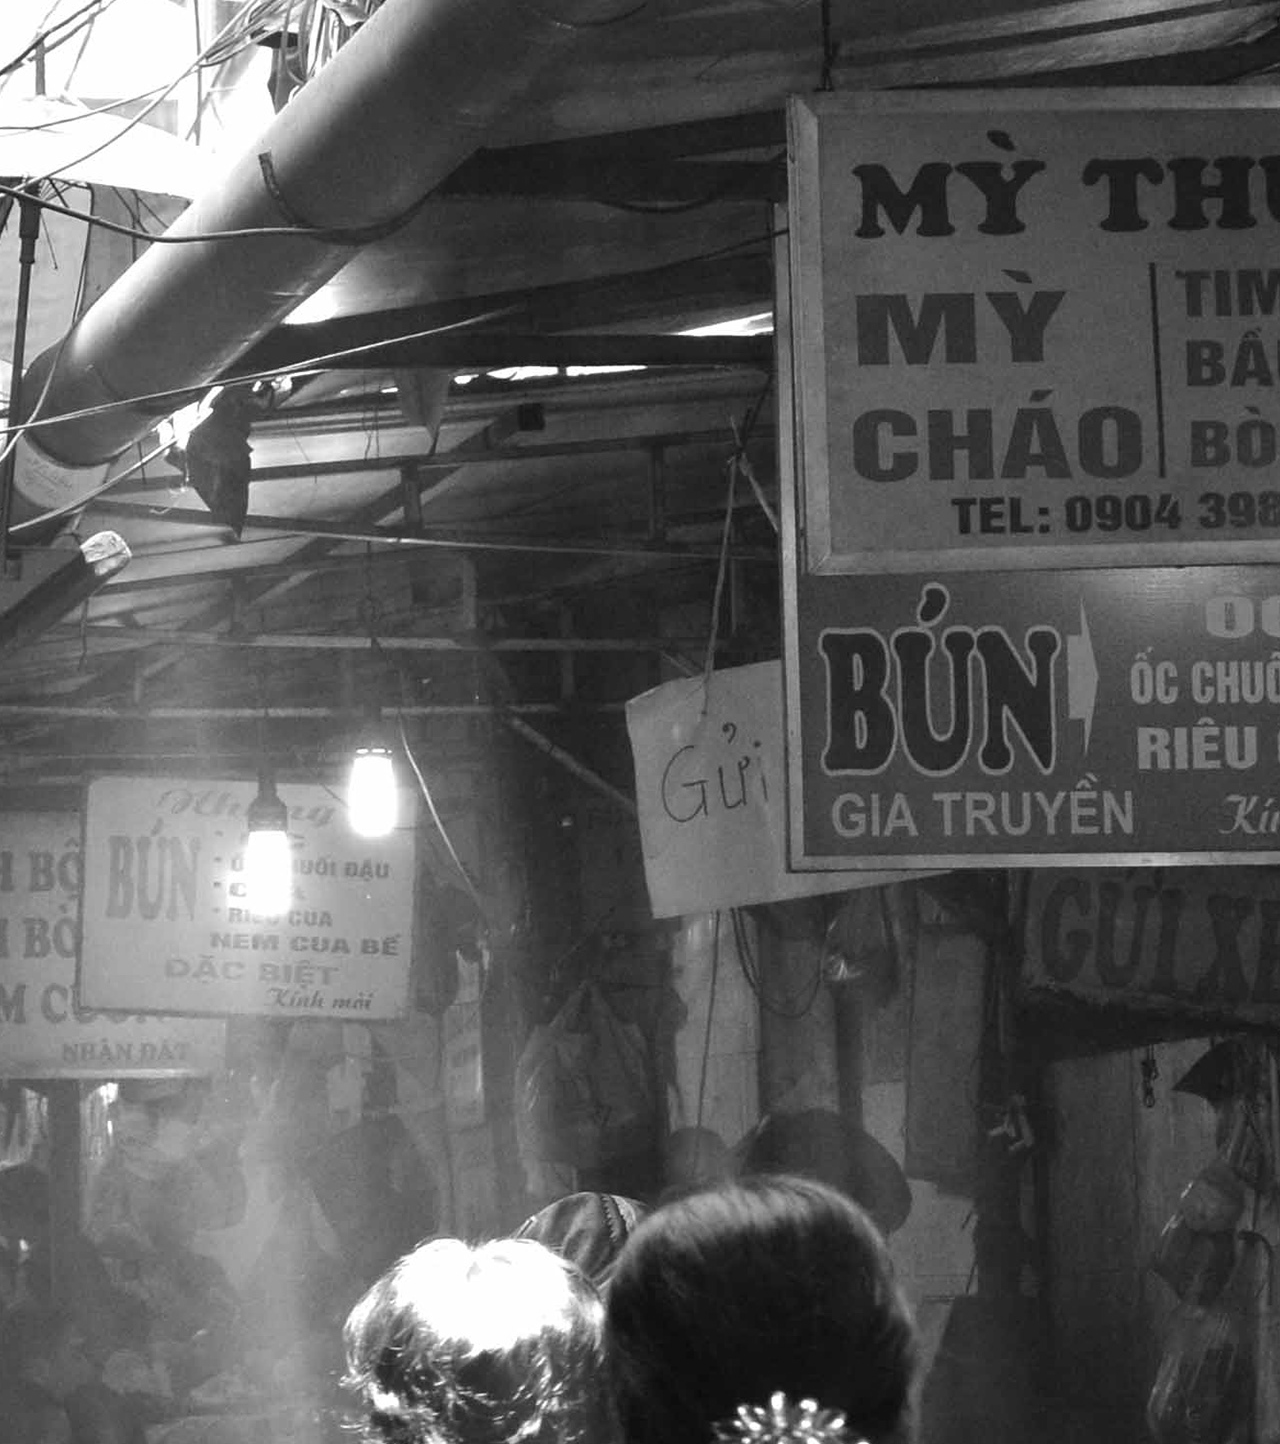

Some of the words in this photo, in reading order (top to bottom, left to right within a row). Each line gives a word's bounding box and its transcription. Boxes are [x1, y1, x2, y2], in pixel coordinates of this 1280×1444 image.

[853, 128, 1045, 239] MỲ
[855, 270, 1067, 366] MỲ
[851, 389, 1144, 482] CHÁO
[1189, 407, 1276, 469] BÒ
[952, 498, 1051, 535] TEL:
[1065, 493, 1181, 531] 0904
[818, 582, 1061, 775] BÚN
[1130, 648, 1178, 705] ỐC
[1137, 717, 1257, 772] RIÊU
[832, 792, 918, 838] GIA
[934, 773, 1134, 834] TRUYỀN
[106, 817, 200, 921] BÚN
[210, 932, 279, 951] NEM
[290, 935, 350, 954] CUA
